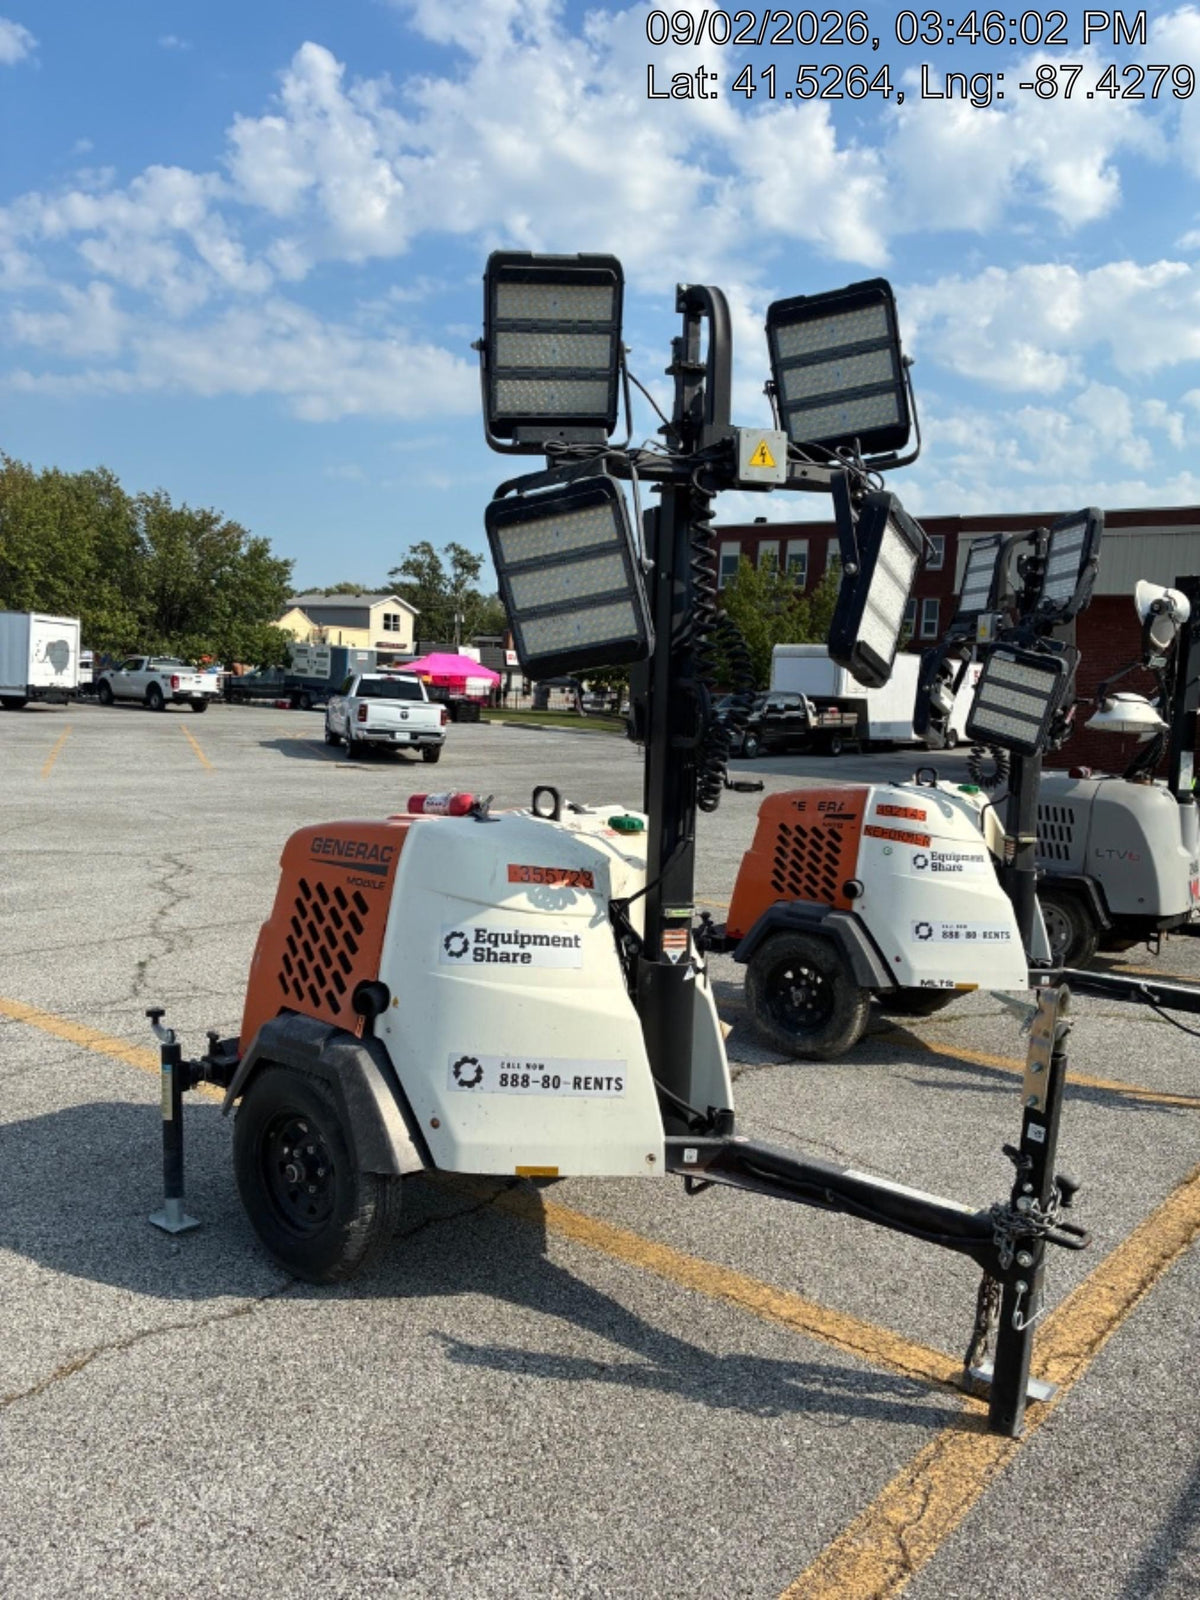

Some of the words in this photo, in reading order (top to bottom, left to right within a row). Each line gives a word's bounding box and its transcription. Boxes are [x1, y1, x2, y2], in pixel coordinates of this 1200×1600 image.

[311, 837, 393, 863] GENERAC
[931, 862, 963, 872] Share
[520, 865, 594, 889] 355723
[474, 928, 581, 948] Equipment
[473, 947, 532, 964] Share
[501, 1062, 521, 1070] CALL
[526, 1063, 545, 1071] NOW
